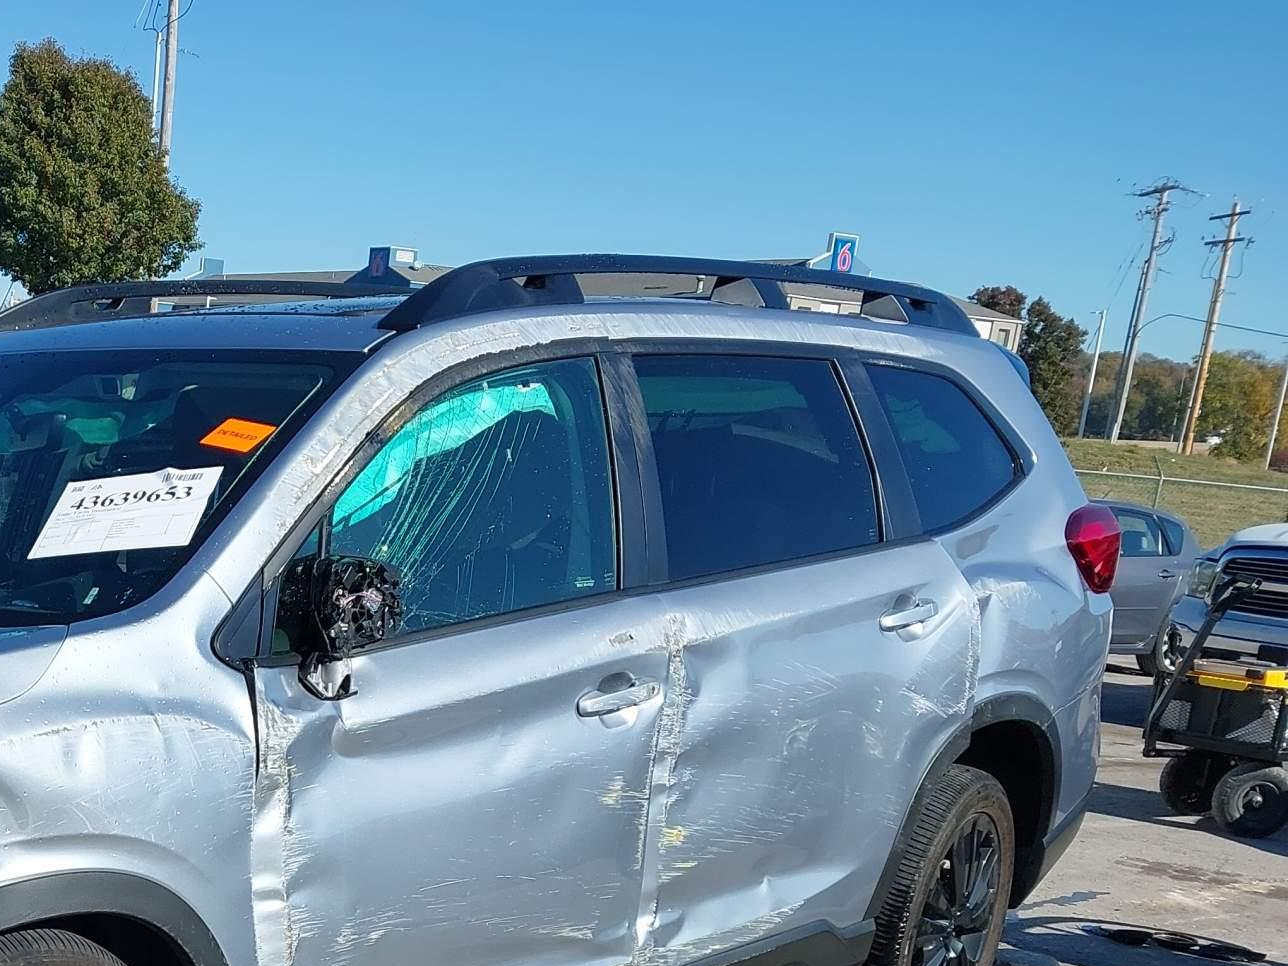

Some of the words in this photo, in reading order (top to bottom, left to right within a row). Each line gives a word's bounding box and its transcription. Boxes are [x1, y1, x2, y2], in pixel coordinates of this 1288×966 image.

[837, 242, 852, 272] 6
[217, 429, 258, 441] DETAILED
[70, 485, 194, 511] 43639653
